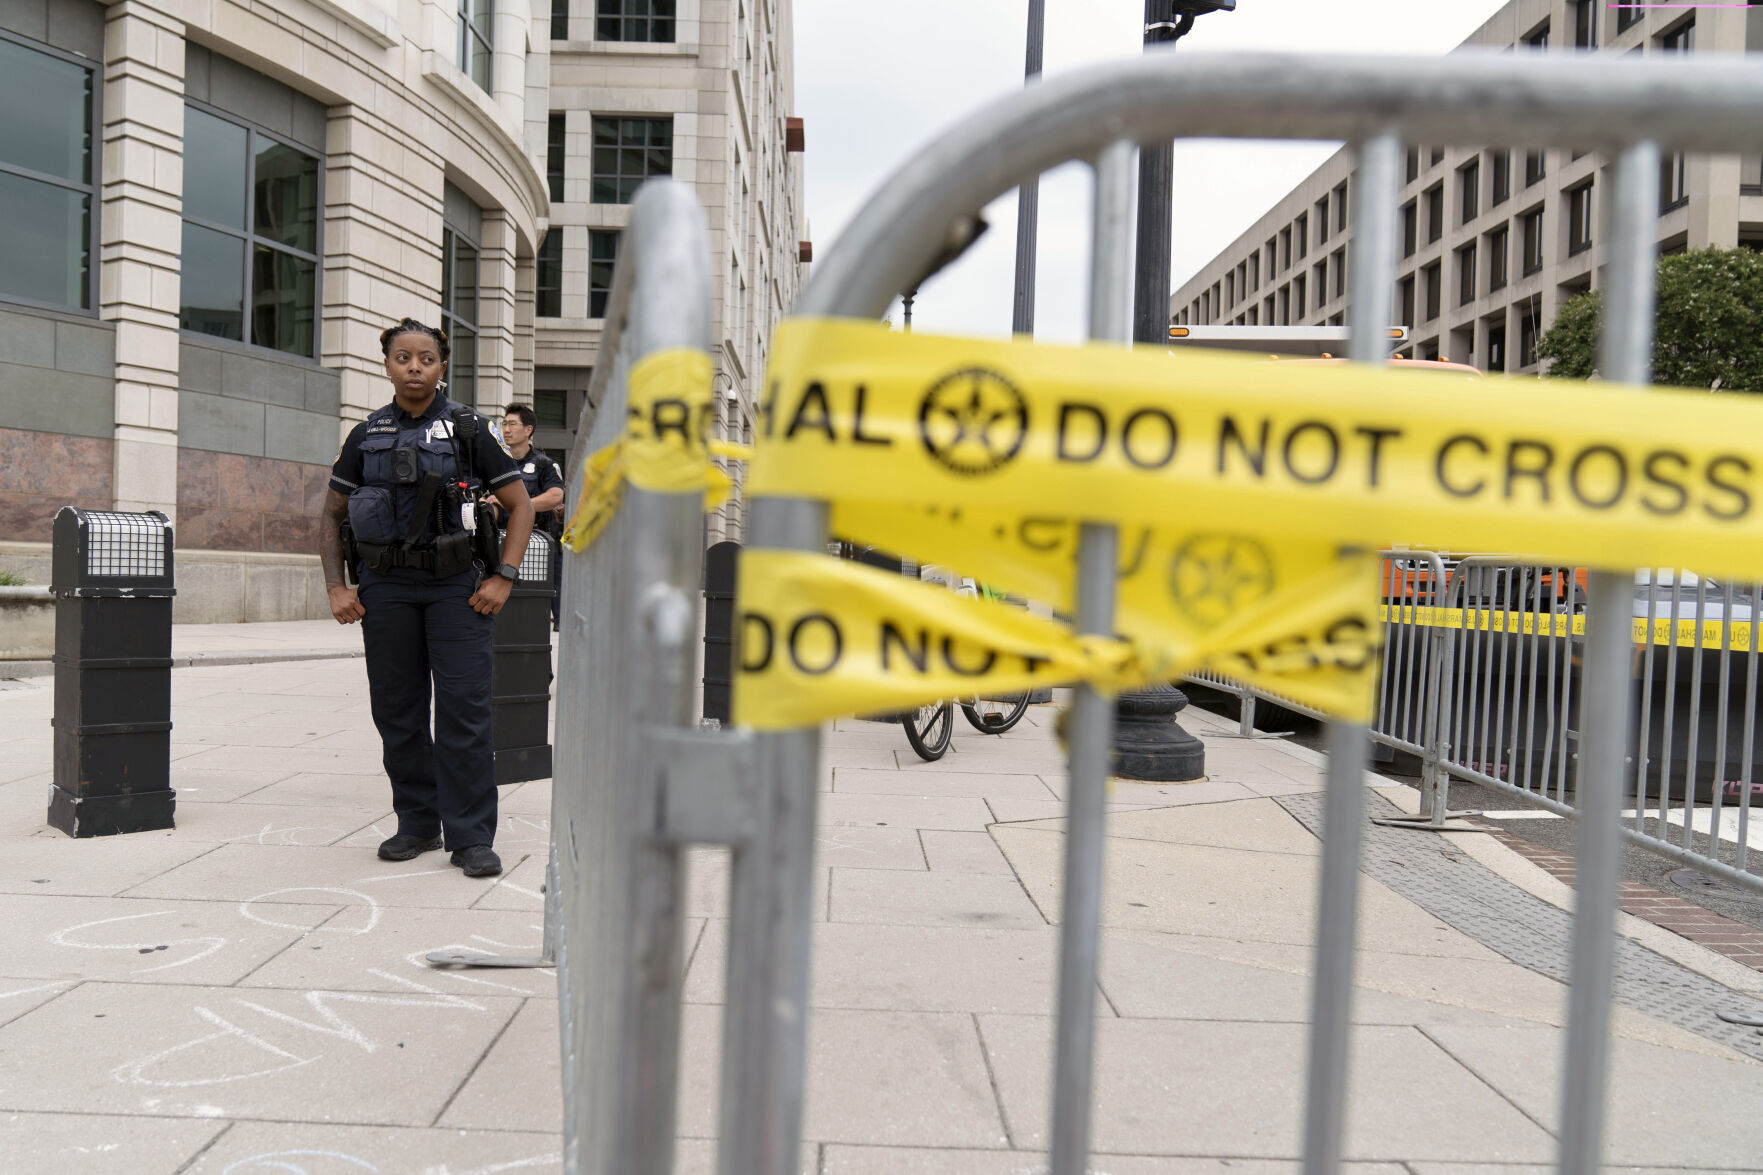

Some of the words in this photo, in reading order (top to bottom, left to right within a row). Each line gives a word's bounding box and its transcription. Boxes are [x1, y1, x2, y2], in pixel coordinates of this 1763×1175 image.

[1056, 403, 1178, 470] DO
[1217, 413, 1403, 488] NOT
[1434, 434, 1753, 520] CROSS
[740, 613, 843, 677] DO
